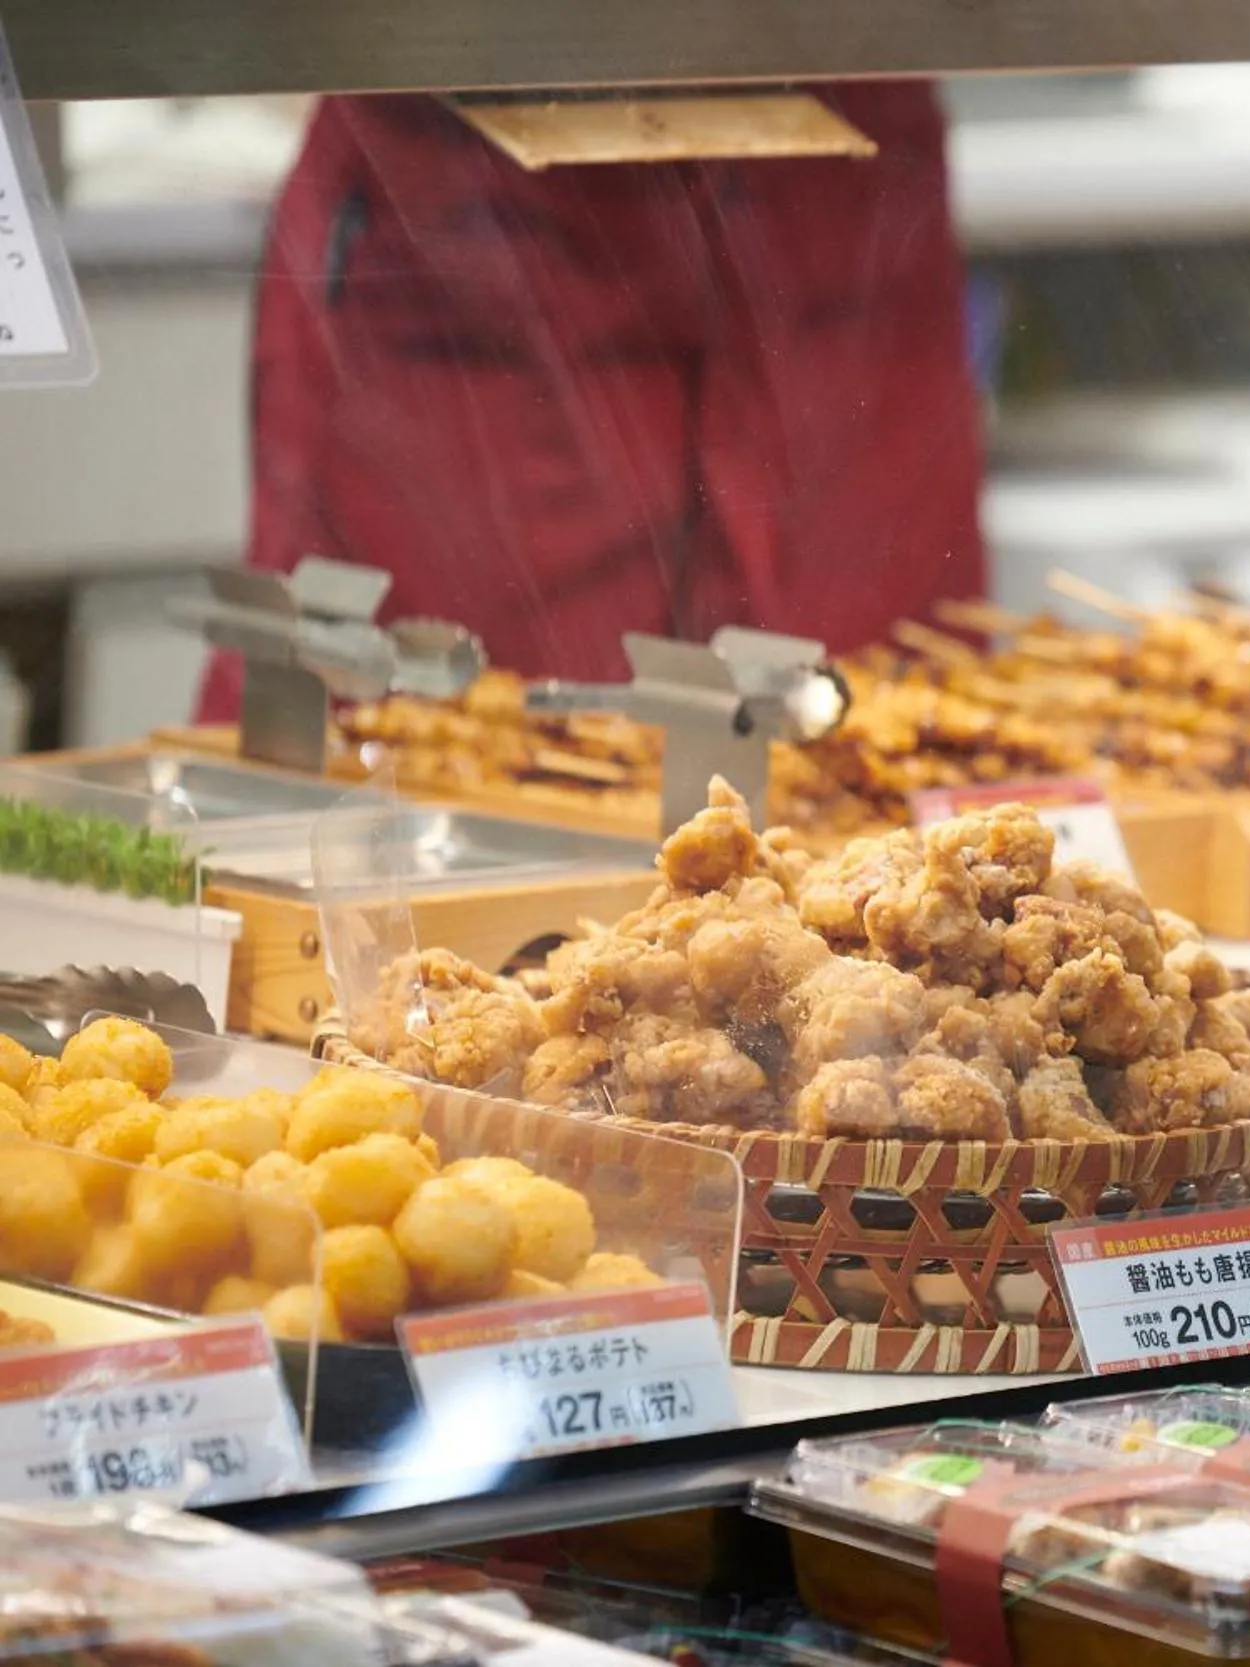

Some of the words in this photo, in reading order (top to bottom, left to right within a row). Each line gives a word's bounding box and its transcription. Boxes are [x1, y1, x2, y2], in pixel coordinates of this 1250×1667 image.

[1123, 1310, 1163, 1328] 本体価格
[1132, 1328, 1171, 1349] 100g
